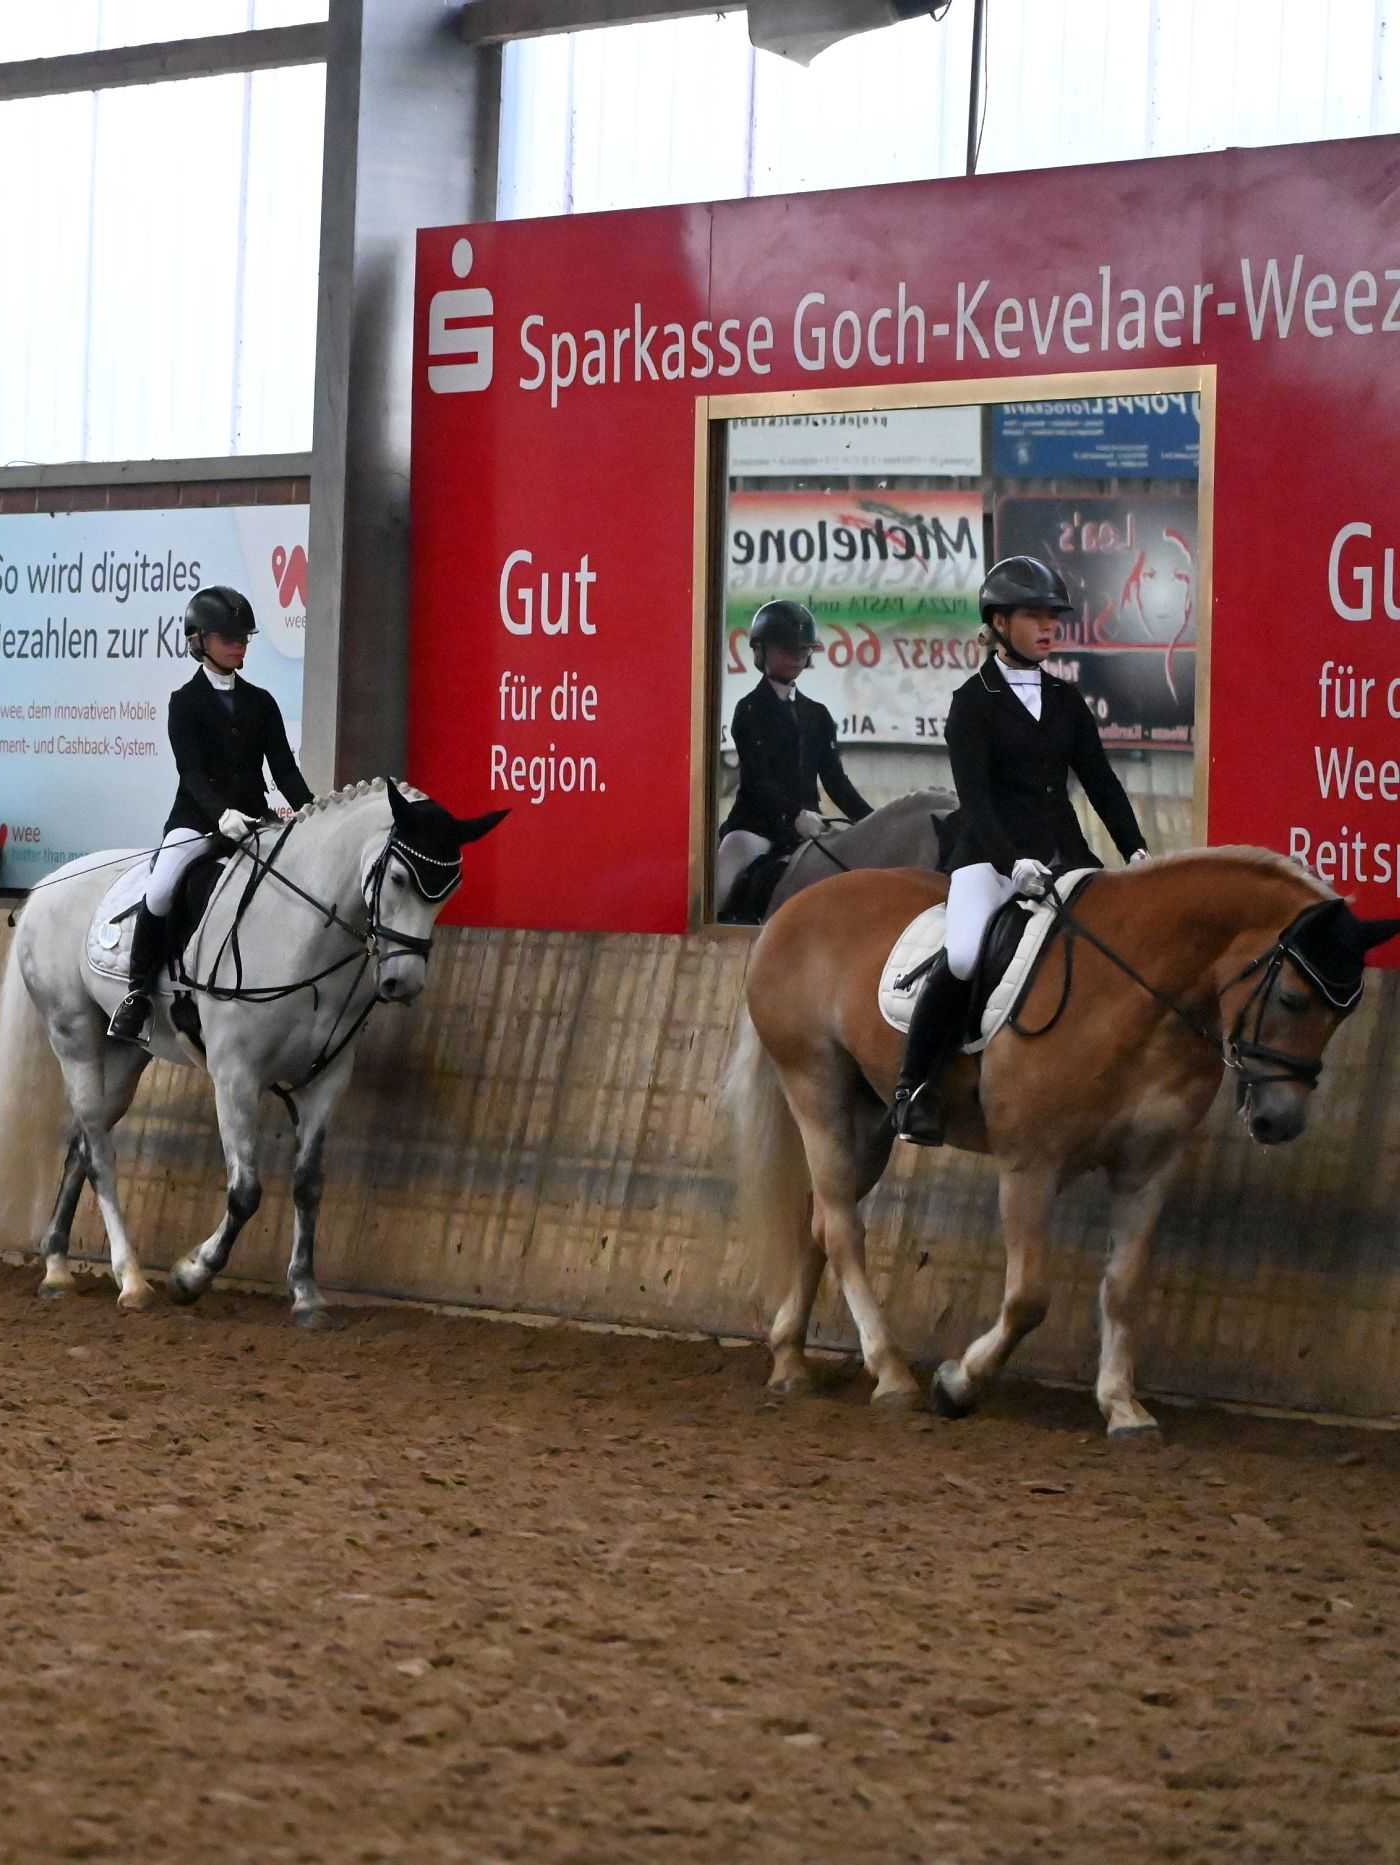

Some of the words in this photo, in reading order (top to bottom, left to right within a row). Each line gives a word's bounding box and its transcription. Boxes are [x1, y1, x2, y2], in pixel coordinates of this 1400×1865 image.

[519, 303, 775, 408] Sparkasse
[27, 552, 83, 593] wird
[92, 549, 201, 603] digitales
[499, 549, 598, 636] Gut
[106, 627, 149, 659] zur
[156, 616, 189, 659] Kü
[1, 702, 26, 722] wee,
[28, 701, 52, 720] dem
[54, 701, 117, 721] innovativen
[119, 701, 158, 721] Mobile
[499, 671, 542, 721] für
[550, 671, 599, 721] die
[1318, 660, 1375, 719] für
[33, 736, 55, 754] und
[56, 736, 158, 760] Cashback-System.
[490, 743, 606, 805] Region.
[12, 825, 42, 843] wee
[1289, 825, 1400, 897] Reits
